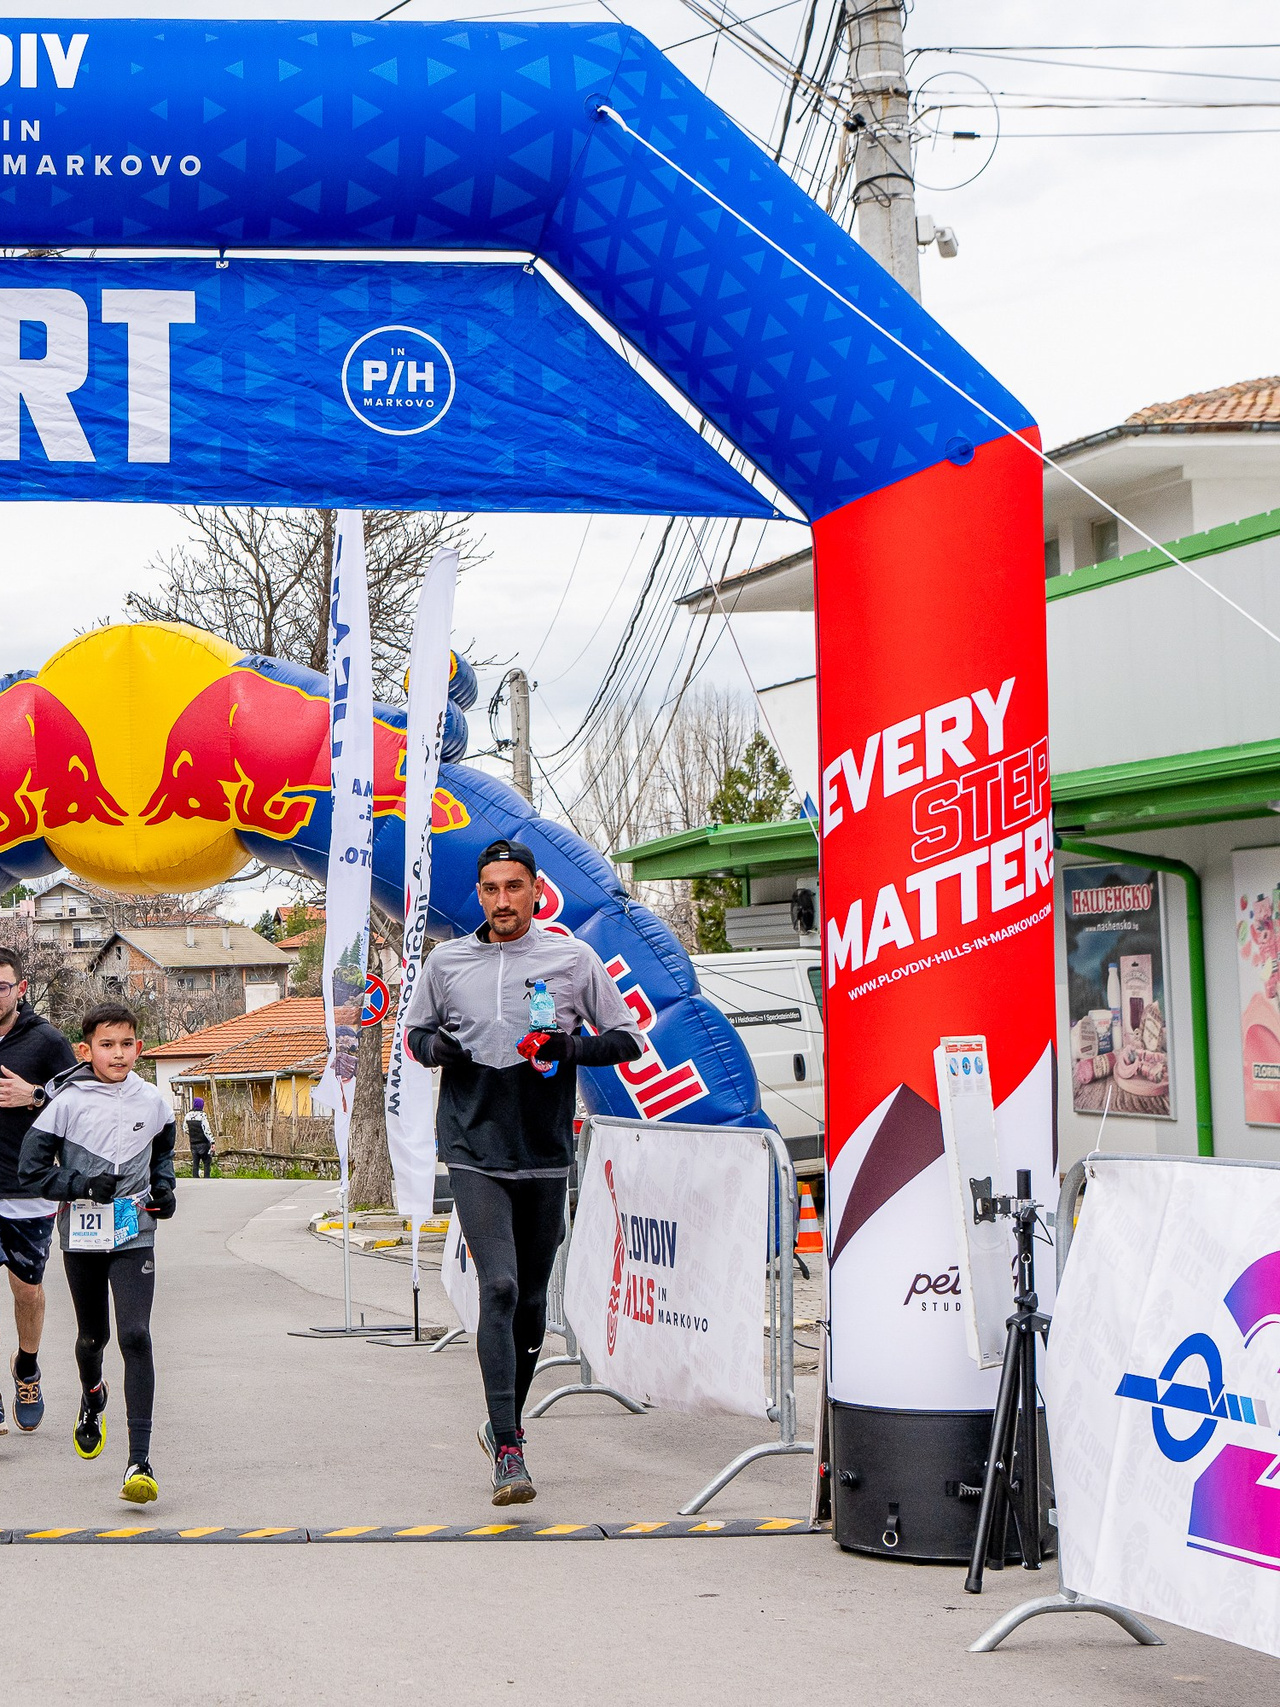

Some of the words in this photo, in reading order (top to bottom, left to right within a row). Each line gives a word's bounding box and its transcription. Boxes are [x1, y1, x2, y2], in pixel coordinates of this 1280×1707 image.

[3, 119, 40, 142] IN
[3, 154, 202, 176] MARKOVO
[390, 347, 406, 355] IN
[363, 360, 435, 394] P/H
[364, 398, 435, 408] MARKOVO
[823, 676, 1016, 838] EVERY
[911, 735, 1049, 862] STEP
[848, 902, 1051, 1000] WWW.PLOVDIV-HILLS-IN-MARKOVO.COM
[80, 1213, 102, 1230] 121
[658, 1287, 667, 1301] IN
[922, 1302, 961, 1311] STUD
[658, 1309, 708, 1332] MARKOVO
